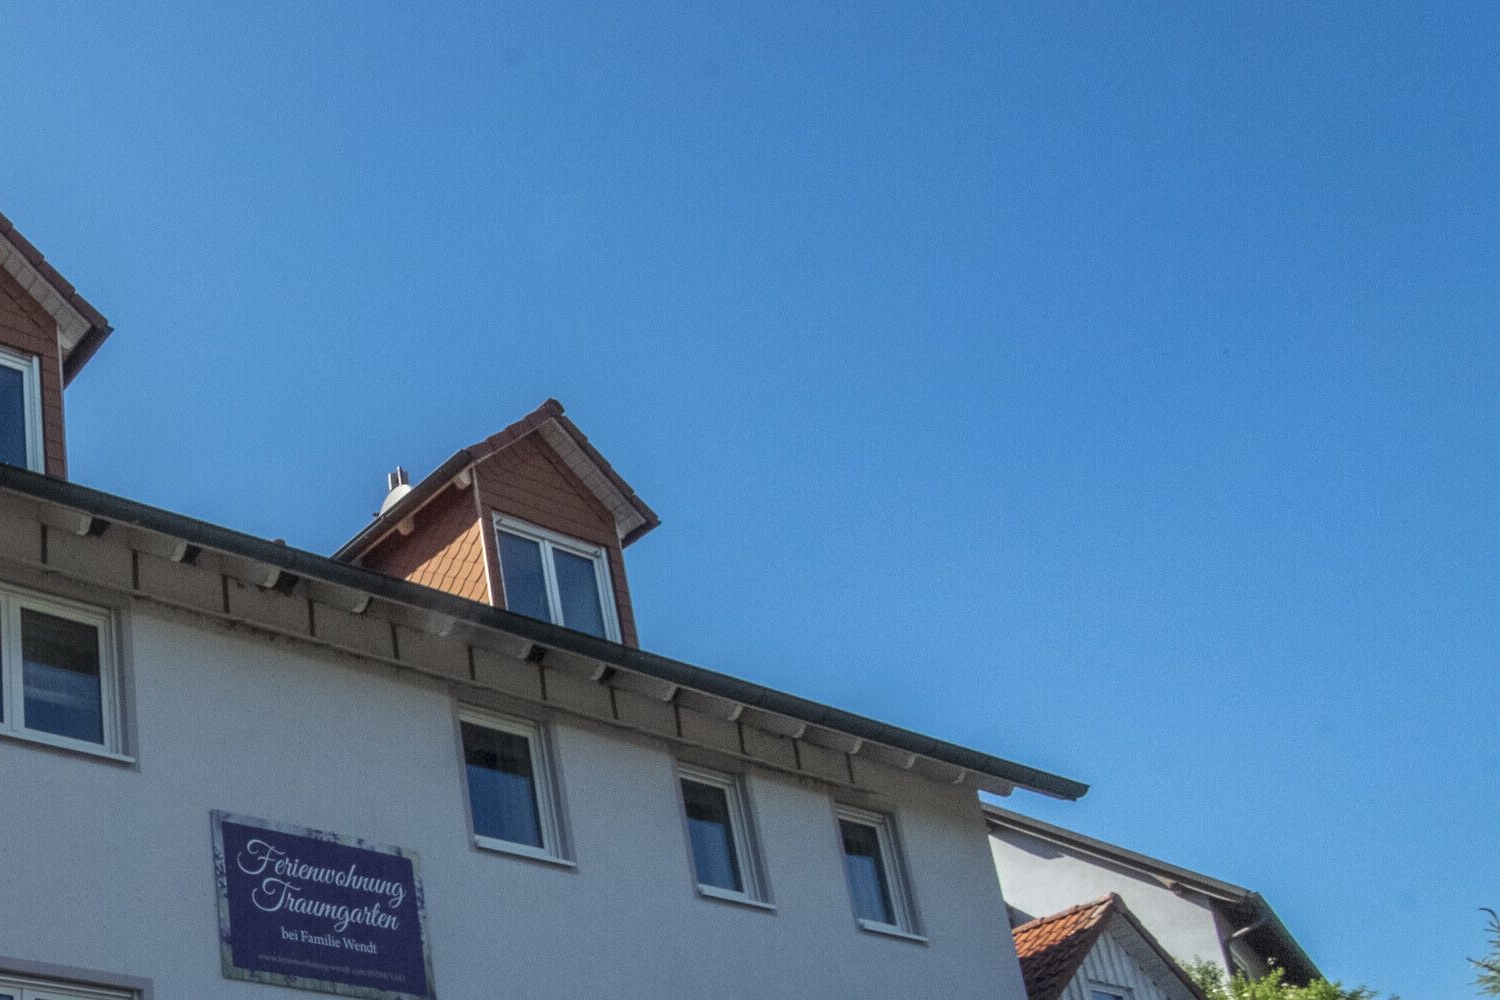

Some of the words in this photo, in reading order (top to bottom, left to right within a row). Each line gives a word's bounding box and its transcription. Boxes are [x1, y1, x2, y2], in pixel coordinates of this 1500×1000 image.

[237, 839, 405, 908] Ferienwohnung
[252, 877, 399, 932] Traumgarten
[281, 926, 298, 941] bei
[300, 930, 341, 948] Familie
[342, 937, 378, 954] Wendt
